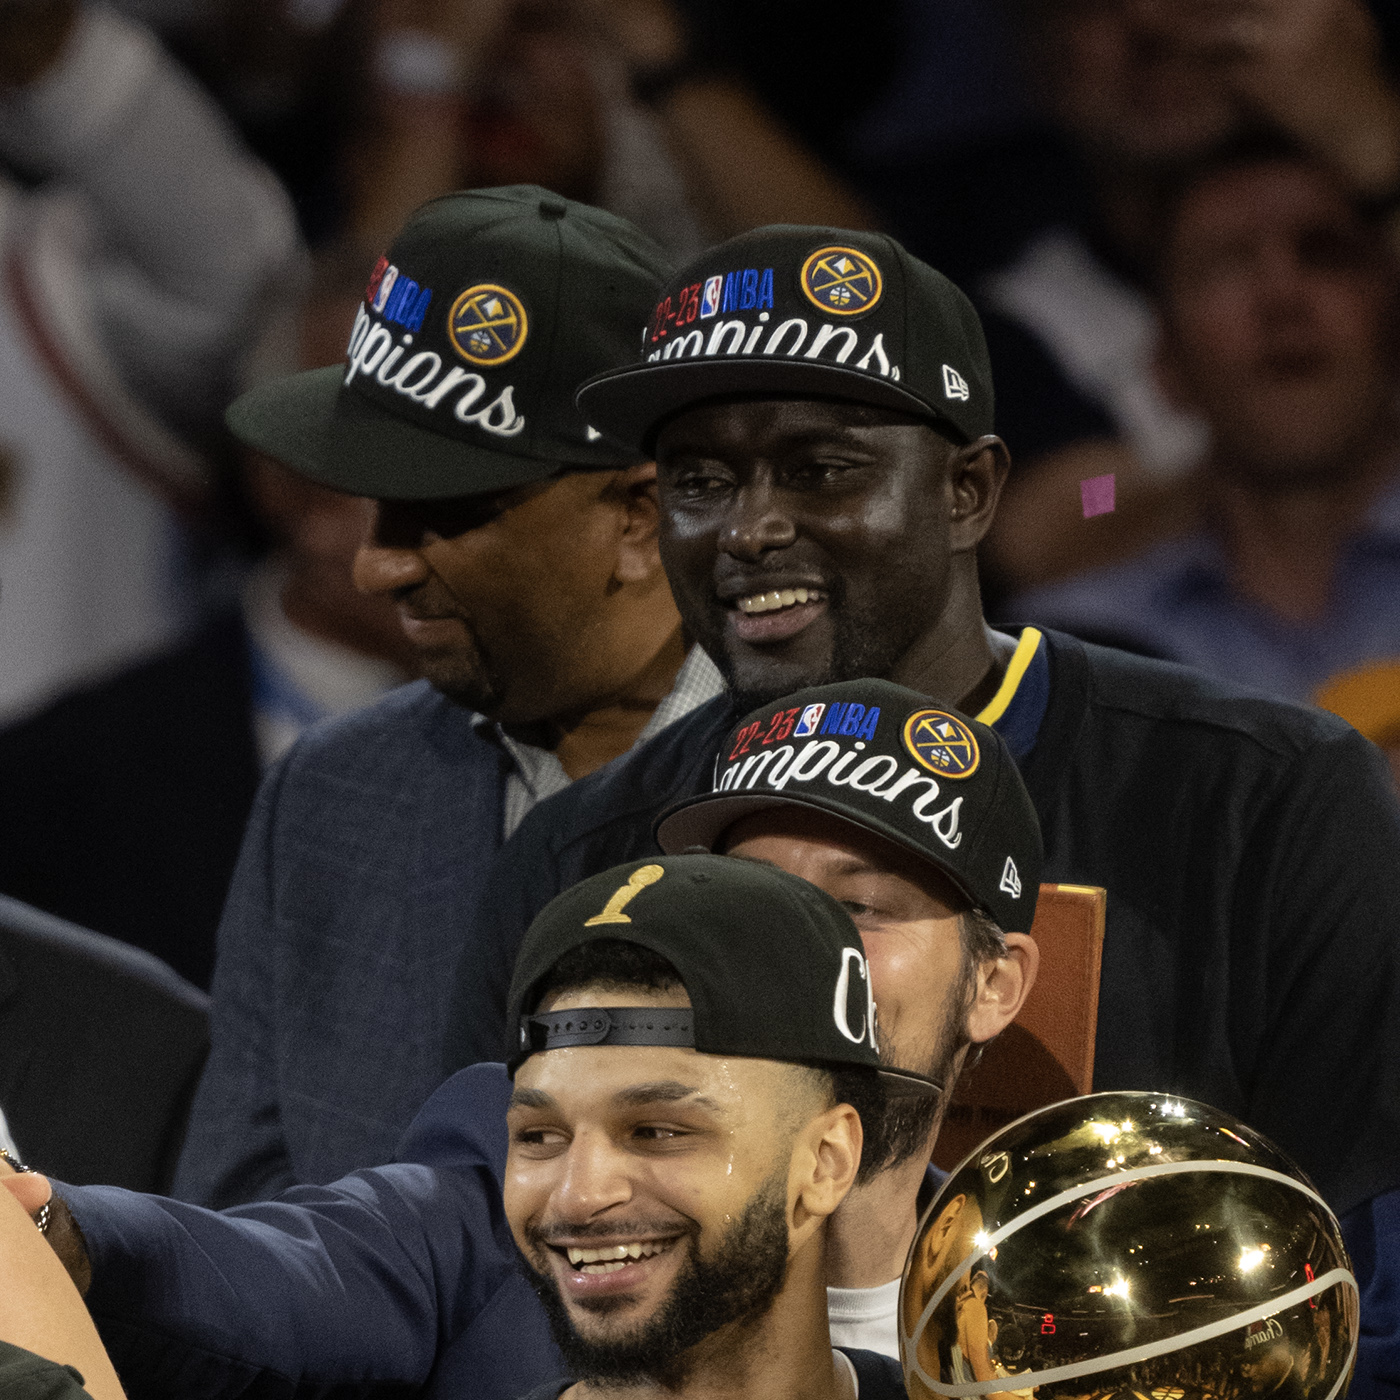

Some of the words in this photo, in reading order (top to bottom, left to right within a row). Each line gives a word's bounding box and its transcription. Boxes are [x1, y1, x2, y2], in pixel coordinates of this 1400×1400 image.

[721, 267, 775, 315] NBA
[728, 706, 801, 762] 22-23
[819, 701, 881, 742] NBA
